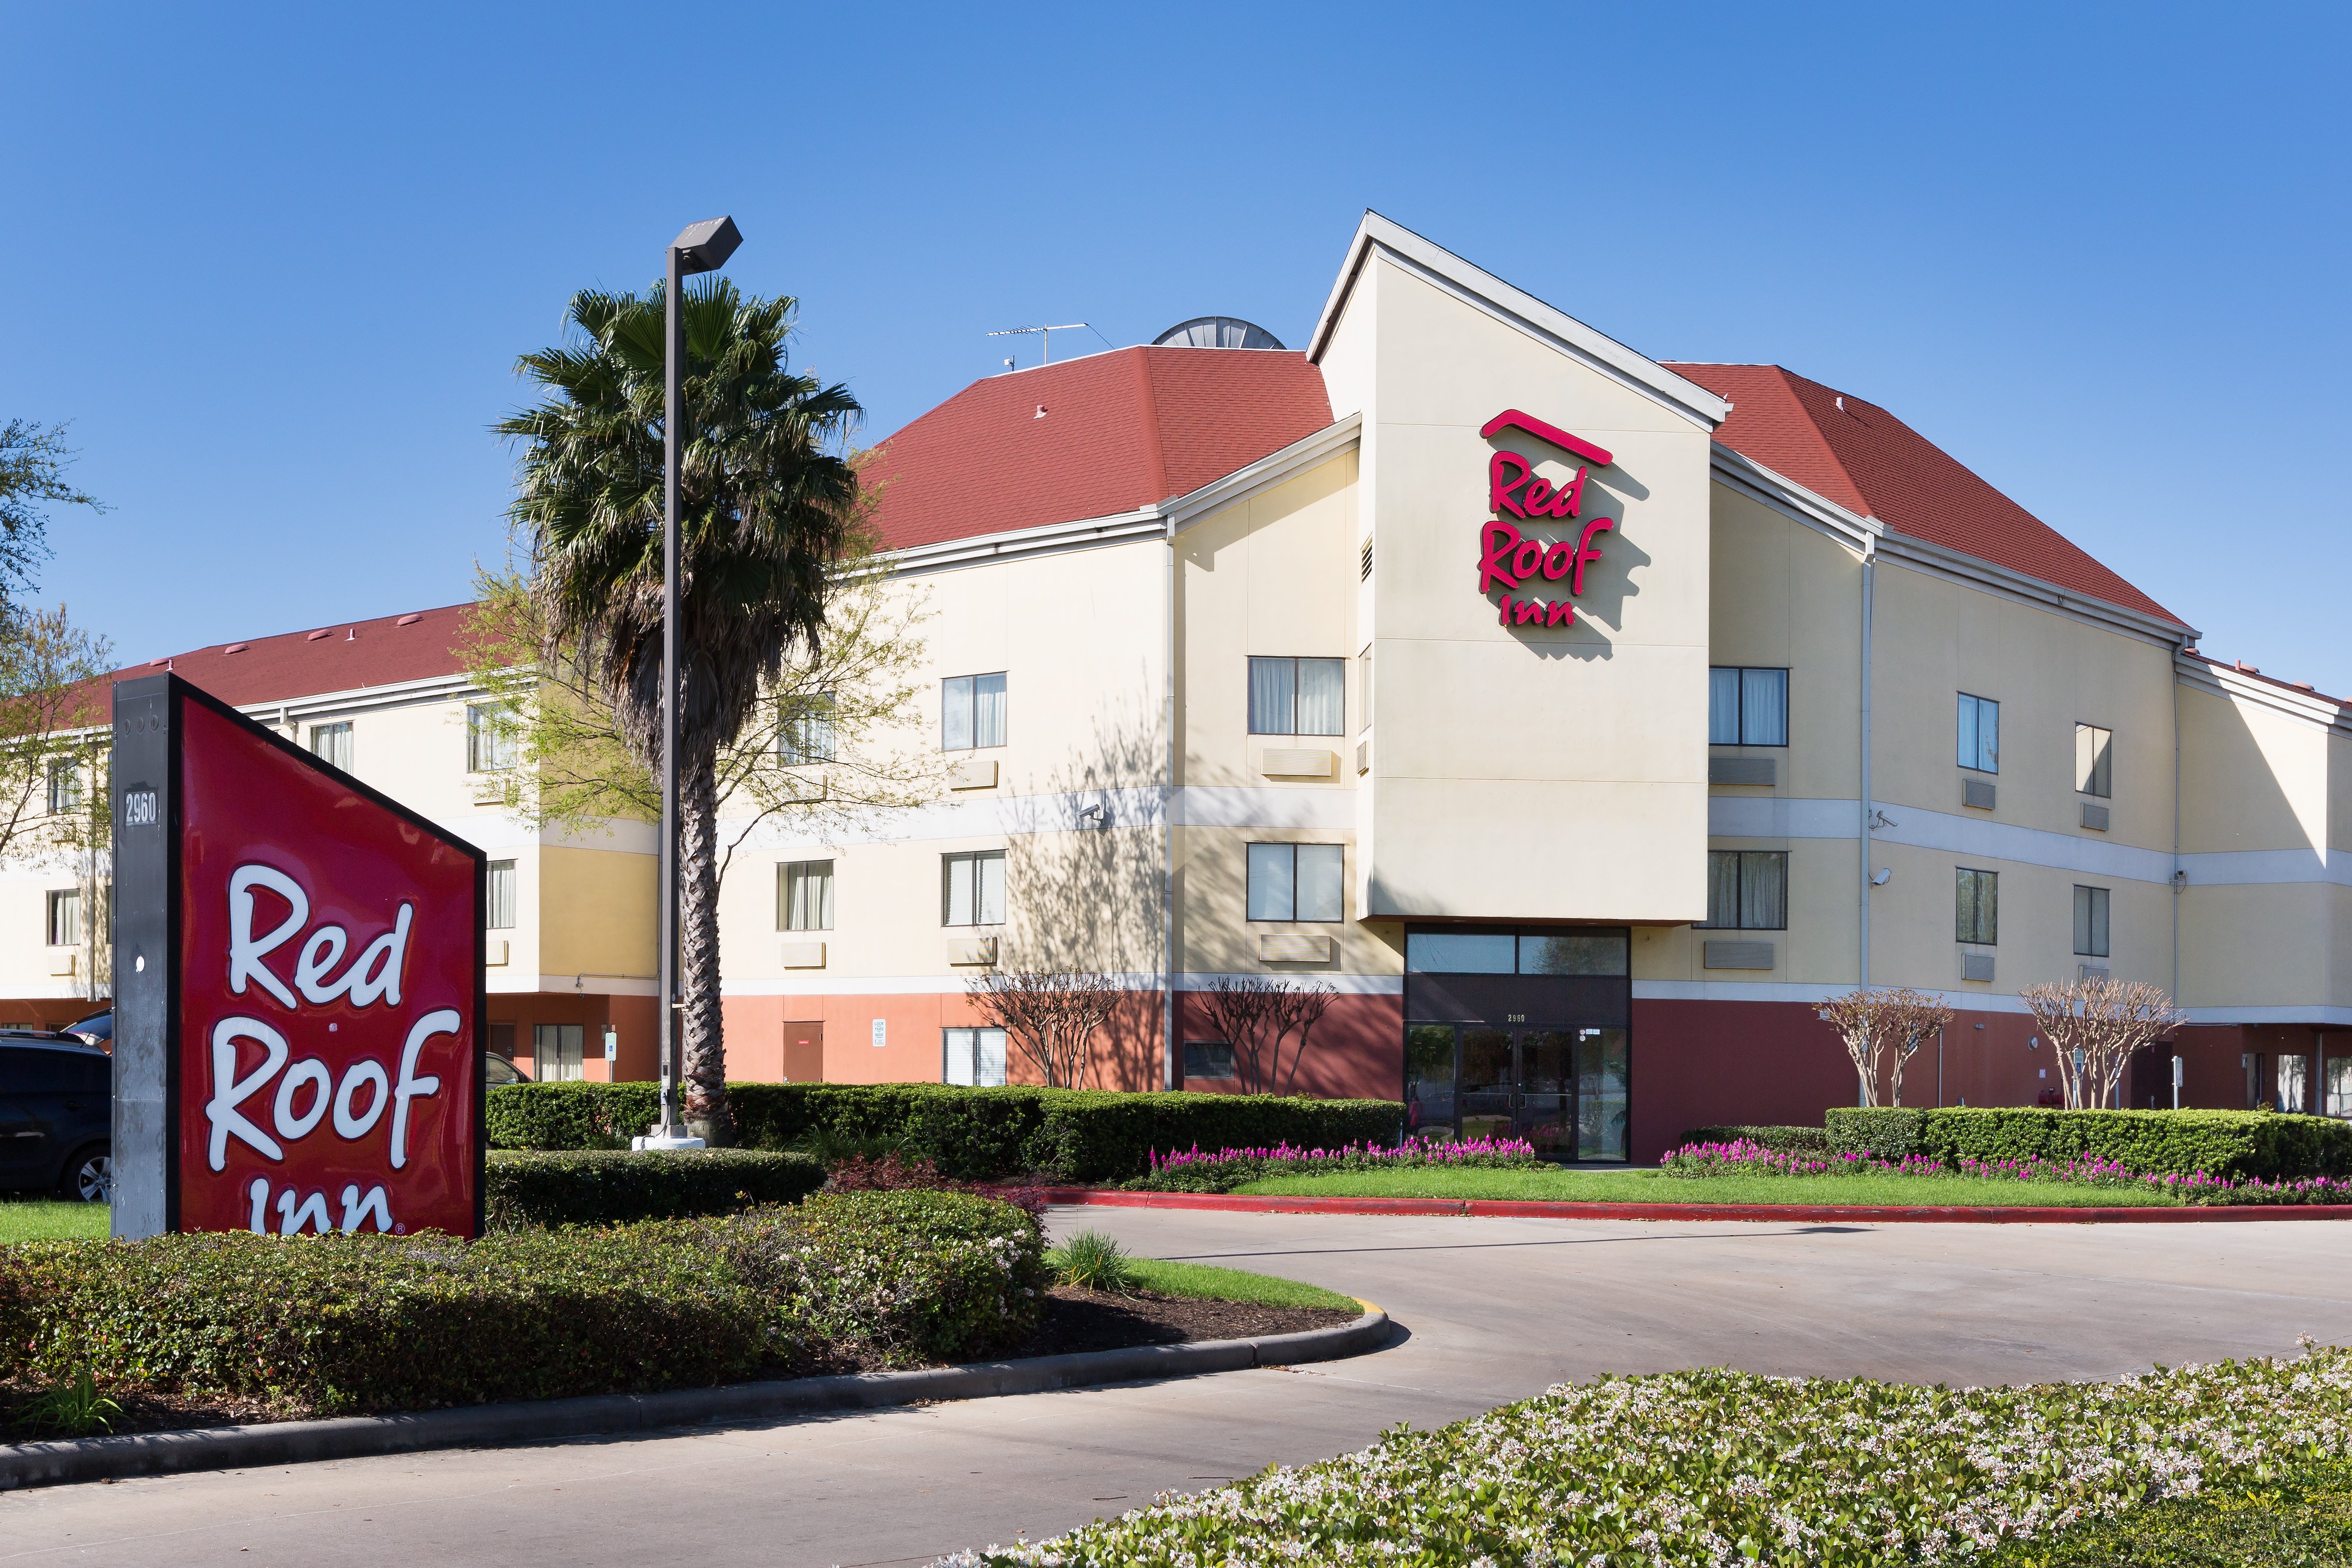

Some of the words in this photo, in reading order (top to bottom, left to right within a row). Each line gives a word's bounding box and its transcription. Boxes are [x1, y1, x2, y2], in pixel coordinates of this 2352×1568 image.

[1490, 450, 1587, 519] Red
[1477, 517, 1614, 596] Roof
[1499, 594, 1575, 627] Inn
[126, 792, 156, 822] 2960
[229, 865, 413, 1009] Red
[206, 1010, 460, 1171] Roof
[250, 1178, 393, 1236] Inn
